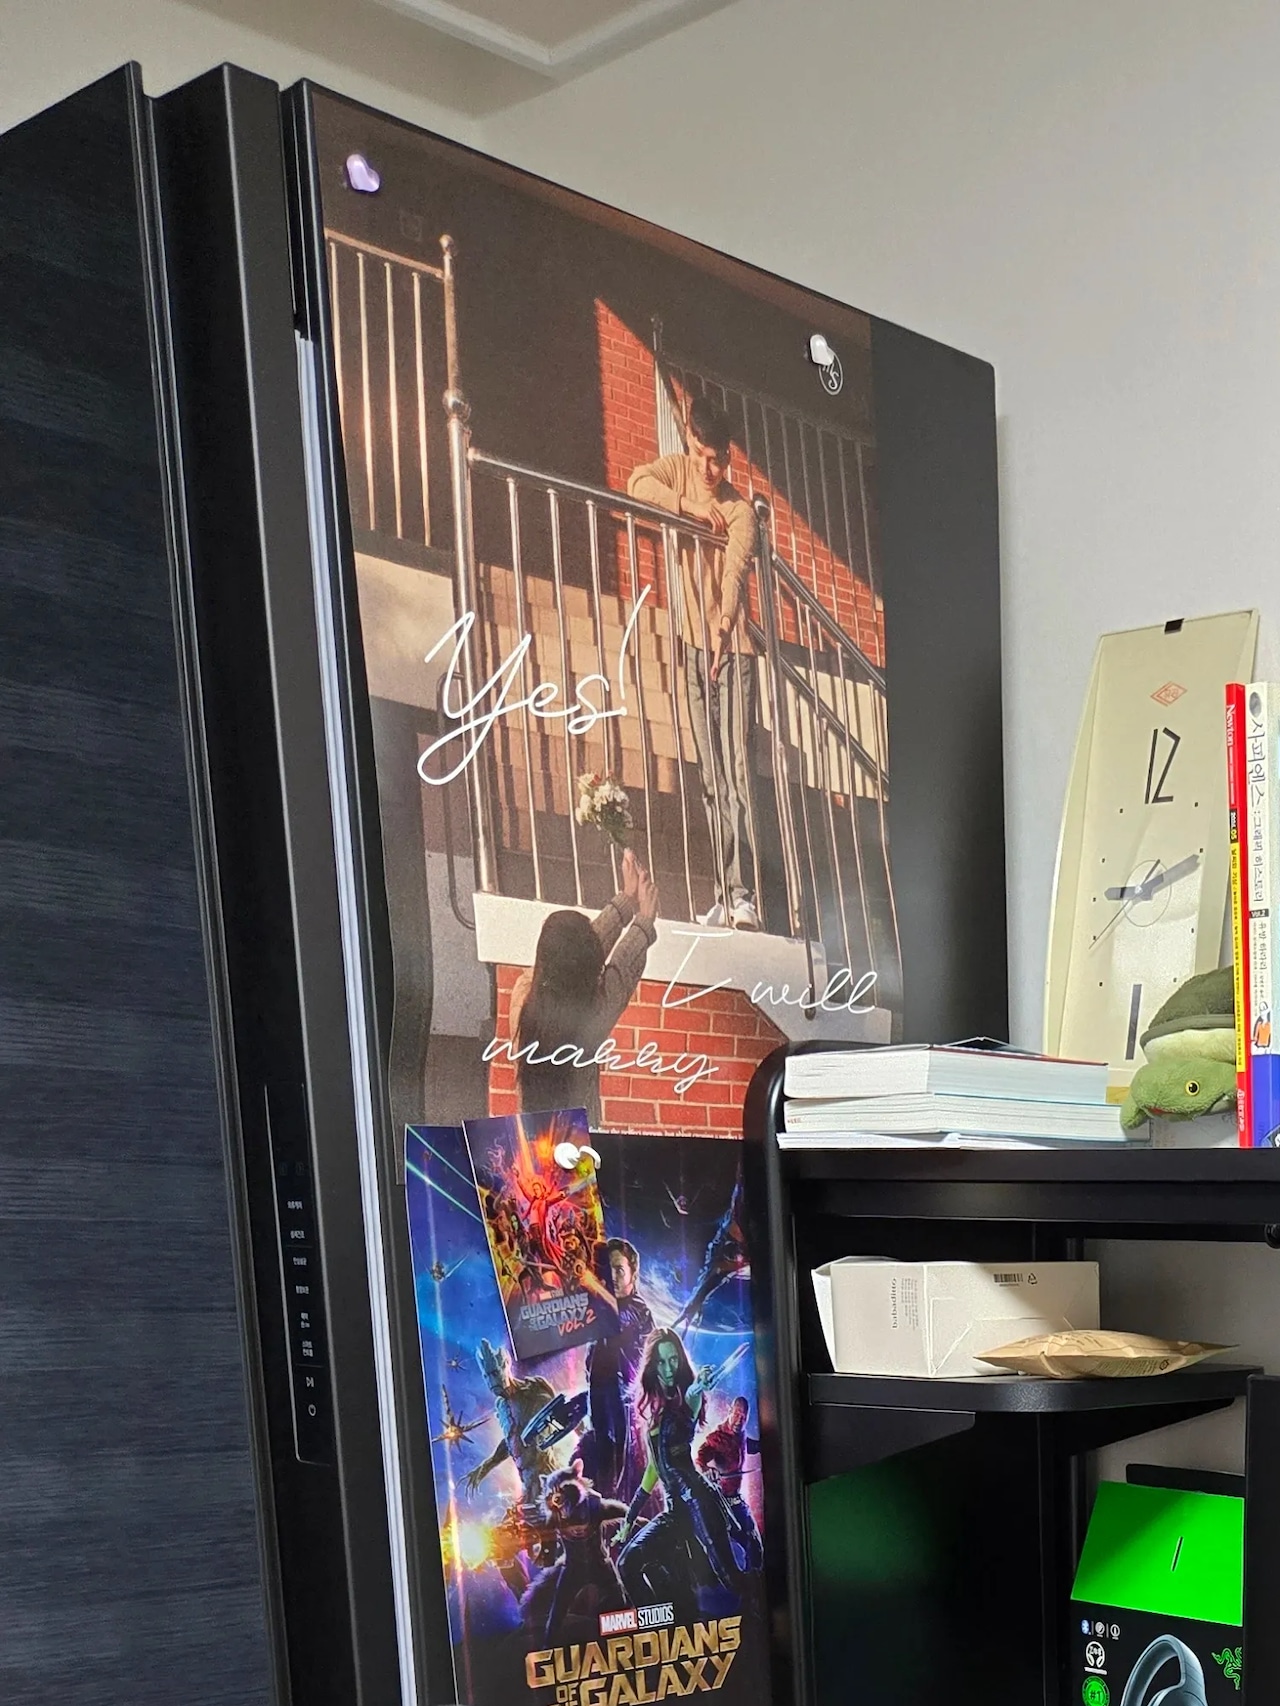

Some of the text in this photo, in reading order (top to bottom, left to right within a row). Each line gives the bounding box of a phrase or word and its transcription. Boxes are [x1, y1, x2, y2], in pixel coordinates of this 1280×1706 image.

[416, 584, 652, 786] Yes!
[1226, 704, 1236, 747] Newton
[1144, 727, 1181, 805] 12
[1247, 719, 1266, 808] 사피엔스
[1252, 856, 1264, 903] 히스토리
[1258, 942, 1268, 970] 하라리
[751, 967, 879, 1016] will
[482, 1036, 720, 1095] marry
[520, 1292, 589, 1320] GUARDIANS
[536, 1306, 587, 1330] GALAXY
[586, 1309, 597, 1324] 2
[601, 1605, 675, 1634] MARVEL STUDIOS
[524, 1615, 743, 1689] GUARDIANS
[556, 1682, 579, 1703] OF
